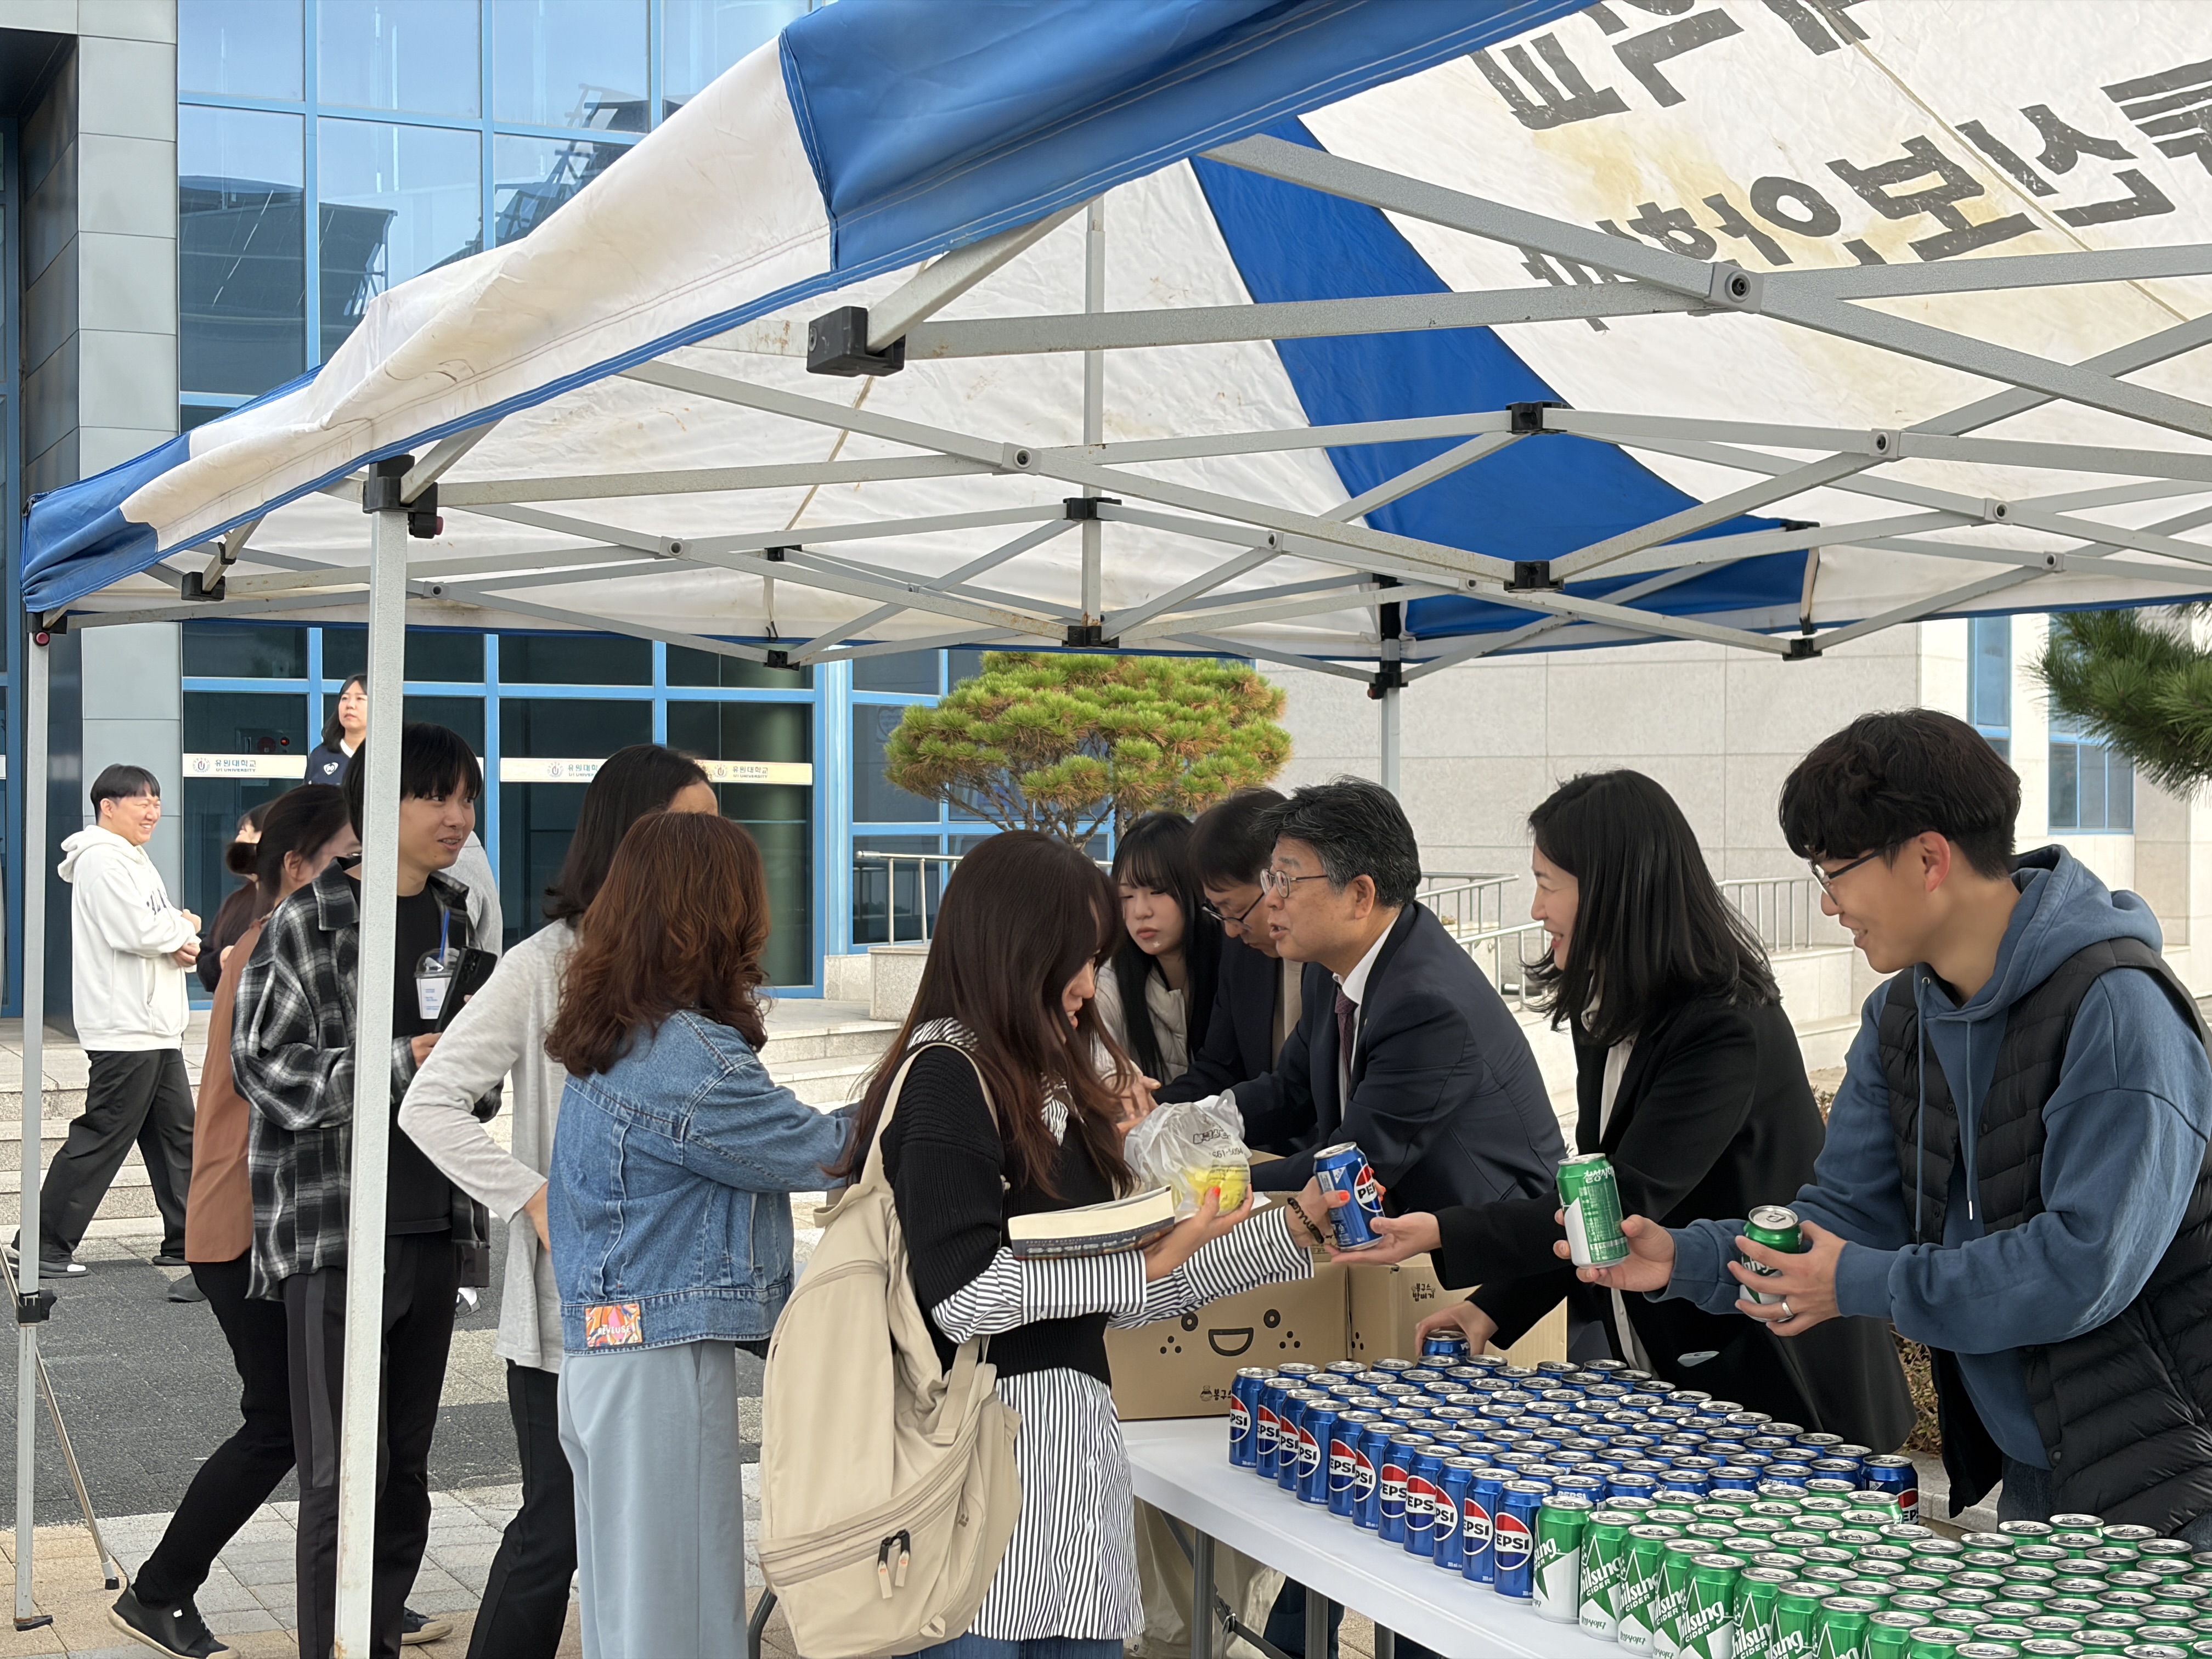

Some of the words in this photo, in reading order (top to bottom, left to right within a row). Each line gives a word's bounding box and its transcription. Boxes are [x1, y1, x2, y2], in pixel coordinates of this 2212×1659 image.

[215, 759, 256, 768] 유원대학교
[732, 766, 768, 774] 유원대학교
[1230, 1413, 1248, 1426] PSI
[1280, 1435, 1299, 1449] PSI
[1299, 1447, 1317, 1461] PSI
[1330, 1458, 1356, 1474] EPSI
[1356, 1470, 1373, 1485] PSI
[1381, 1482, 1407, 1499] EPS
[1406, 1494, 1435, 1511] EPS
[1436, 1507, 1454, 1523] PSI
[1464, 1520, 1489, 1536] EPSI
[1496, 1532, 1530, 1550] EPSI
[1586, 1578, 1611, 1596] CIDER
[1625, 1593, 1651, 1612] CIDER
[1656, 1607, 1679, 1626] CIDER
[1685, 1624, 1711, 1643] CIDER
[1740, 1641, 1768, 1659] CIDER
